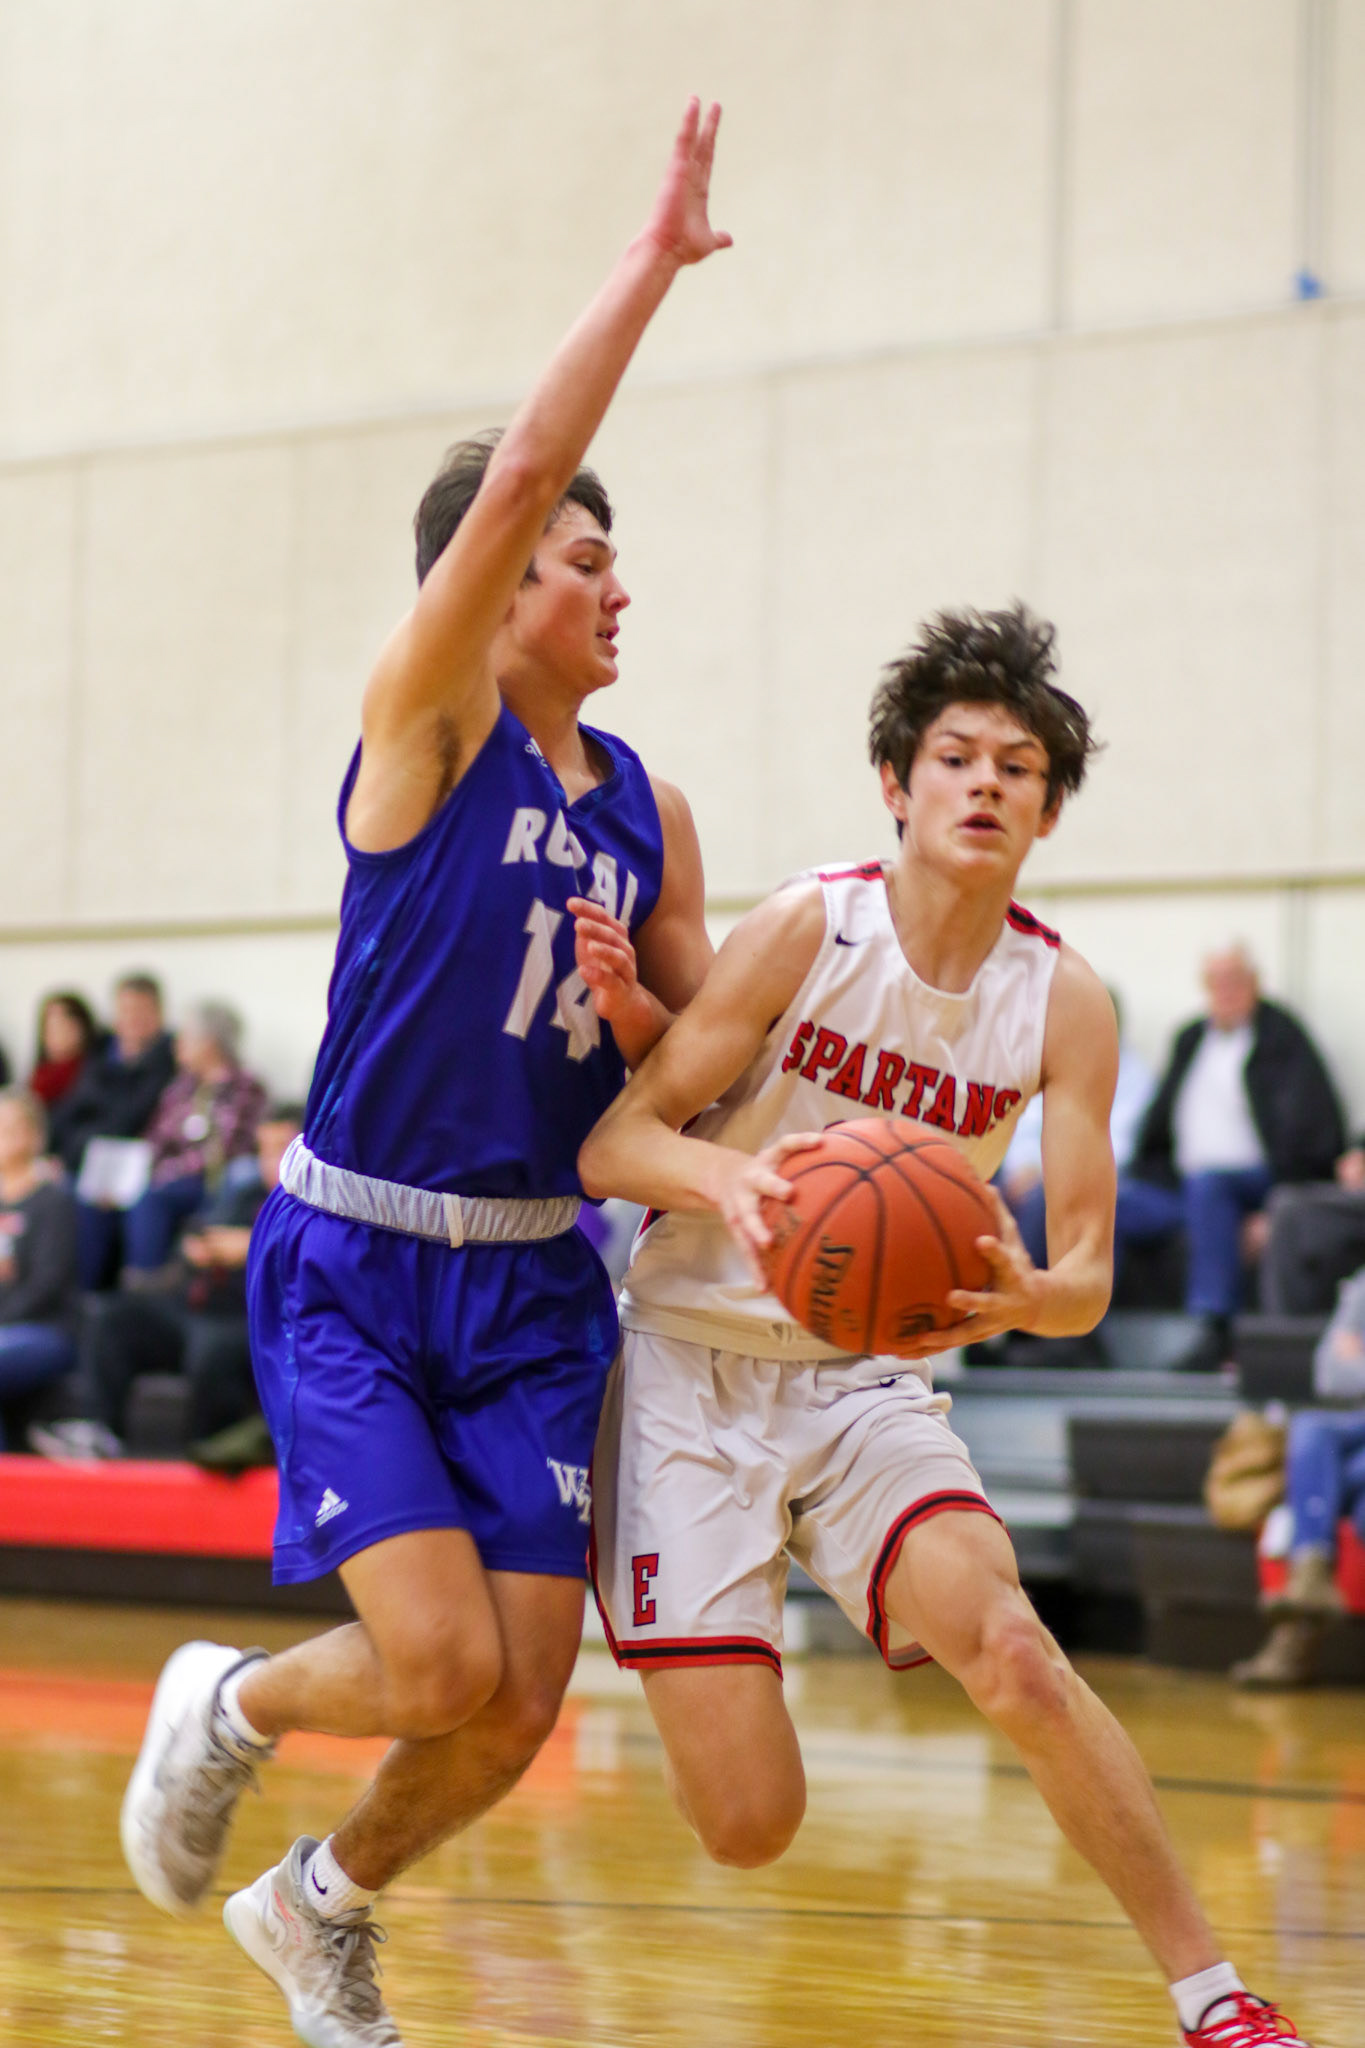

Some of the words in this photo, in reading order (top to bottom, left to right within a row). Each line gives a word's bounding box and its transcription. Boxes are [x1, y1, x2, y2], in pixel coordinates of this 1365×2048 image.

[502, 897, 601, 1064] 14
[782, 1019, 1022, 1139] SPARTANS
[631, 1552, 660, 1628] E
